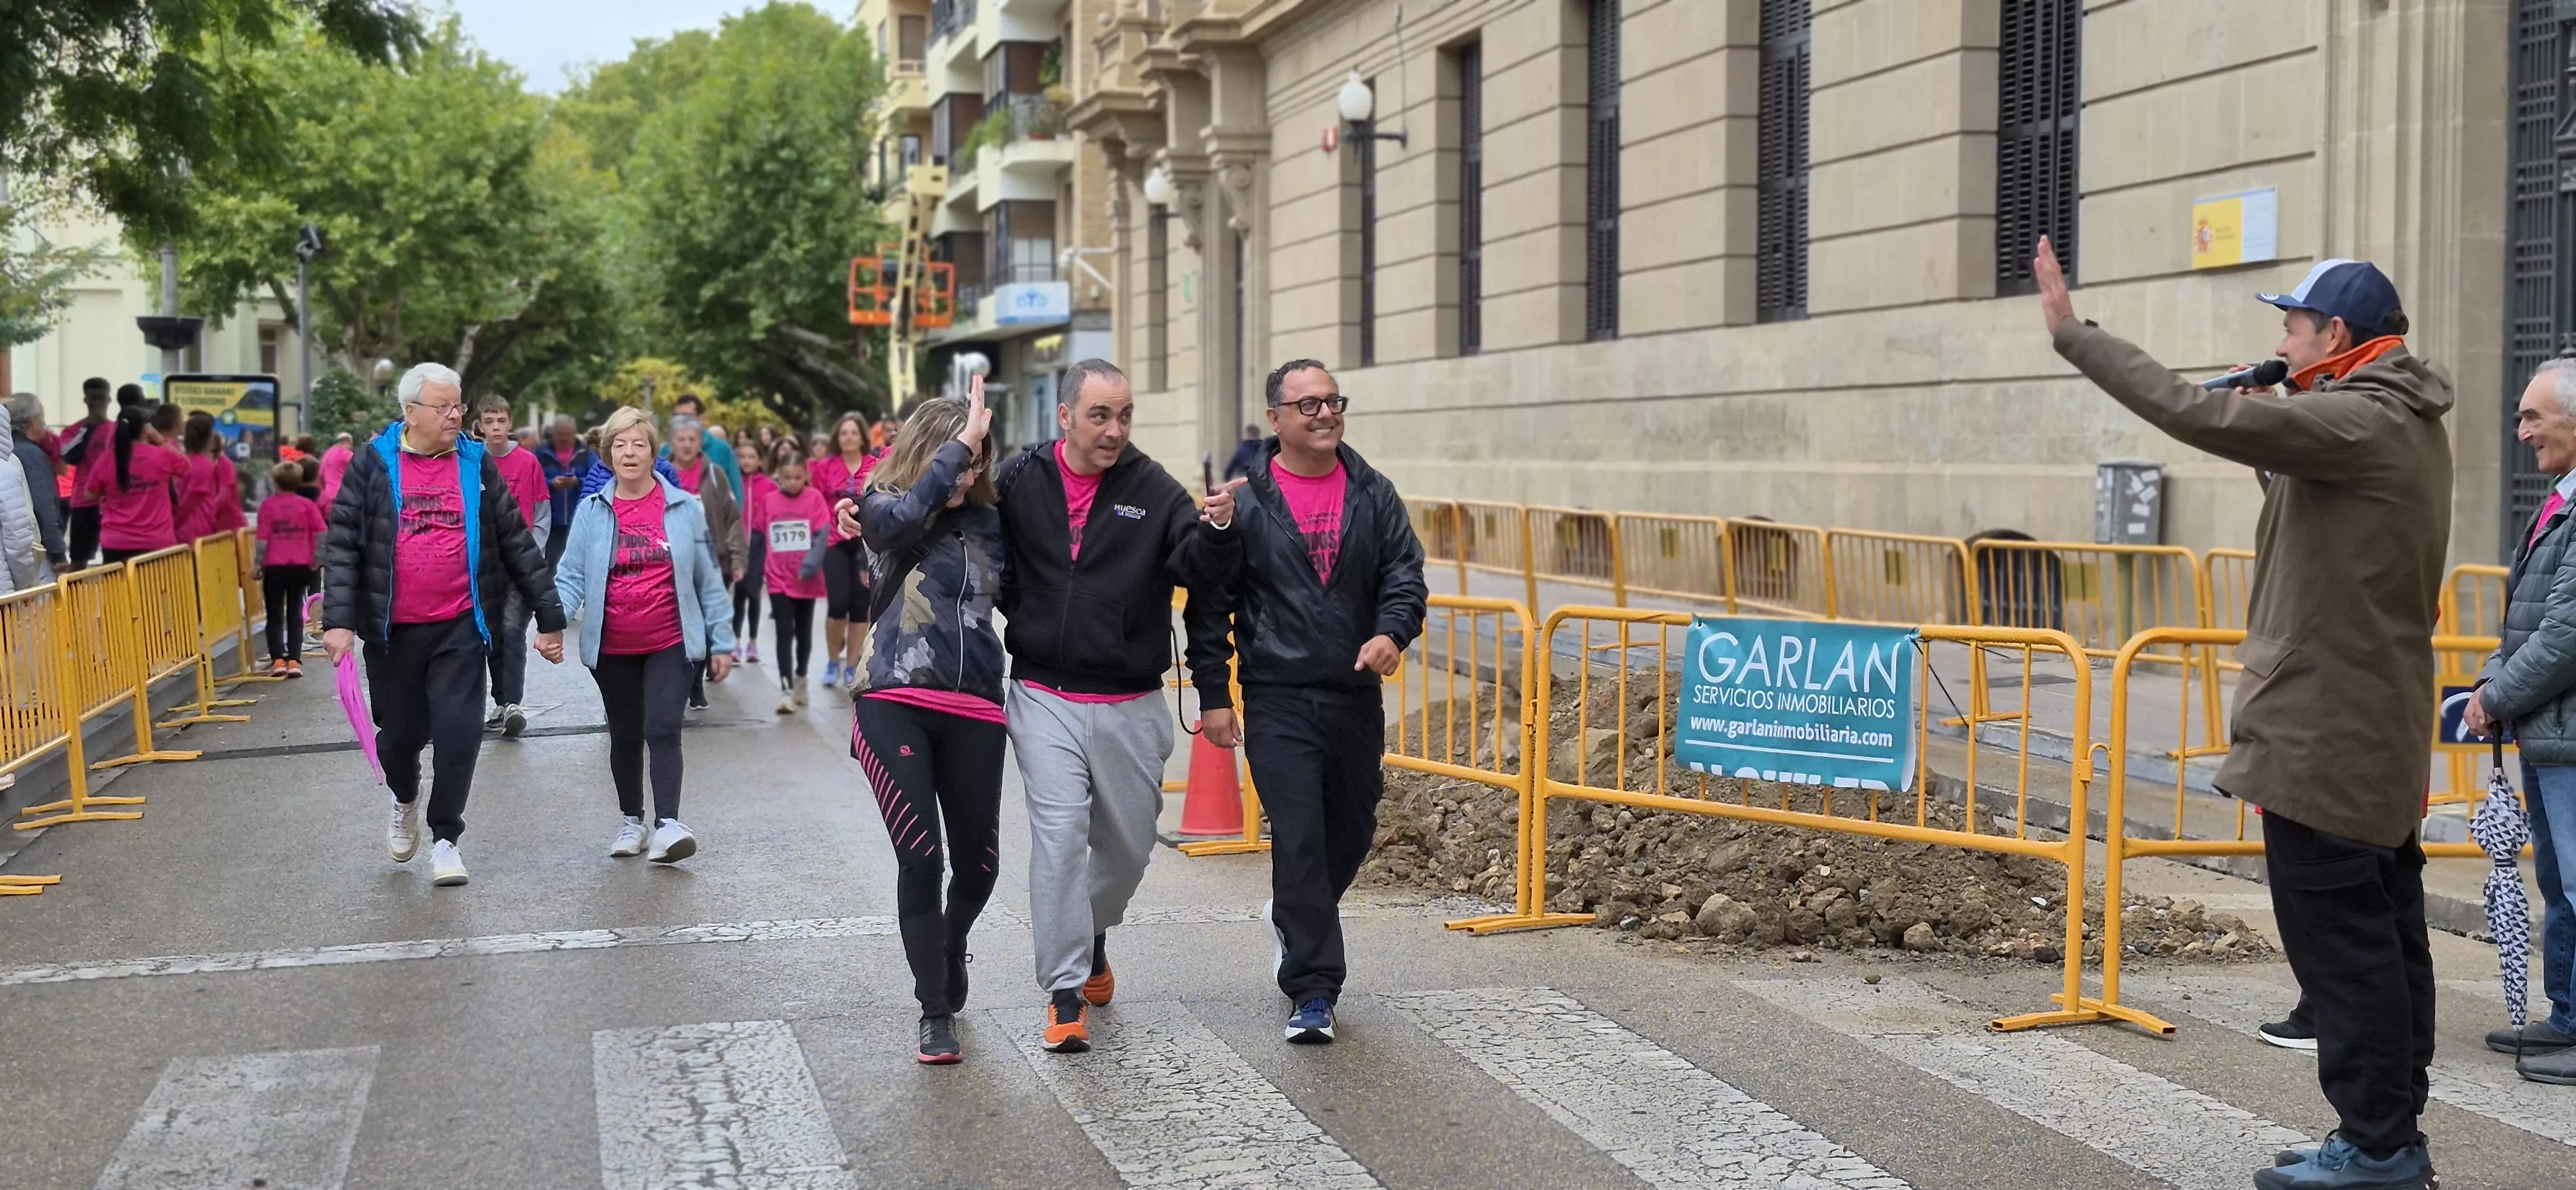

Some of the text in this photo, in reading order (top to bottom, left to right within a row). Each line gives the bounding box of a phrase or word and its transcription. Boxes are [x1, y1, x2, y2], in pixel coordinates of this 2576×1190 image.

[773, 531, 806, 543] 3179
[1698, 632, 1901, 695] GARLAN
[1692, 684, 1895, 719] SERVICIOS INMOBILIARIOS
[1690, 716, 1893, 748] www.garlaninmobiliaria.com
